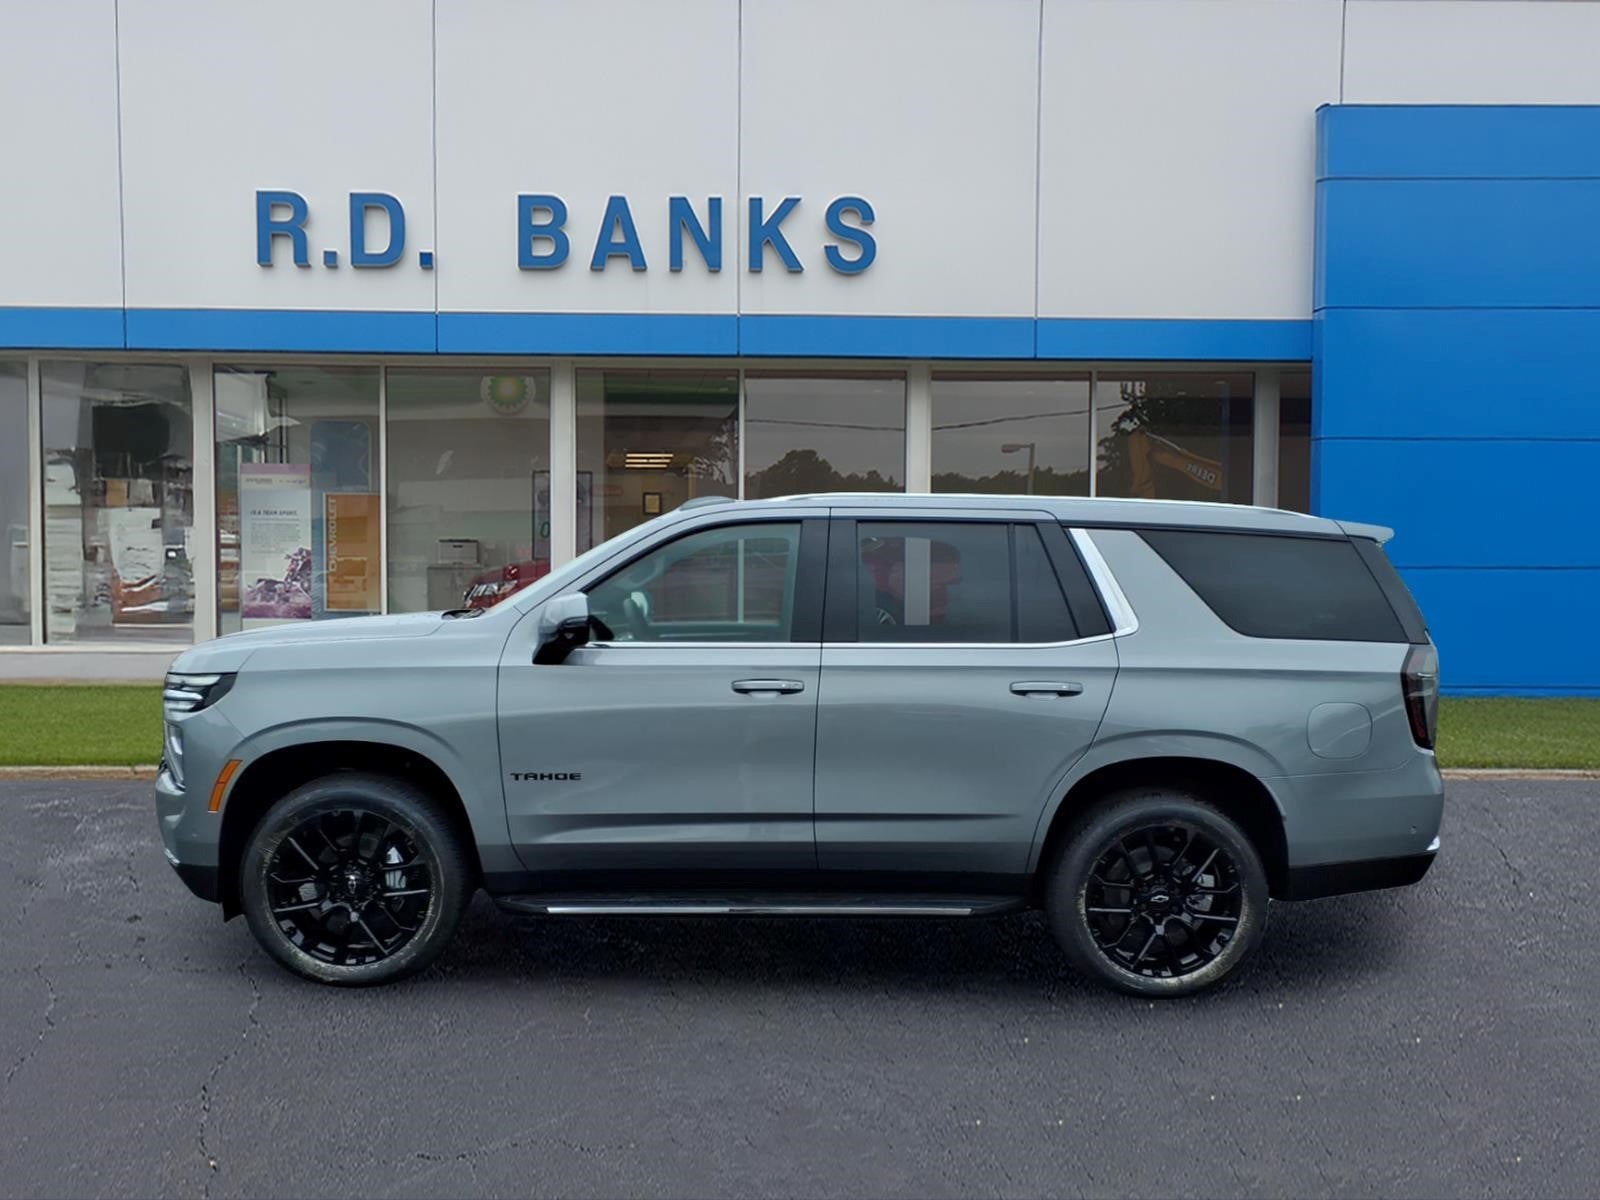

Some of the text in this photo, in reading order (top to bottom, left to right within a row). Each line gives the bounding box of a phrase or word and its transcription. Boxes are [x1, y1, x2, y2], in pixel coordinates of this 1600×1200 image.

[255, 190, 877, 276] R.D. BANKS
[327, 498, 337, 572] CHEVROLET
[510, 772, 582, 781] TAHOE
